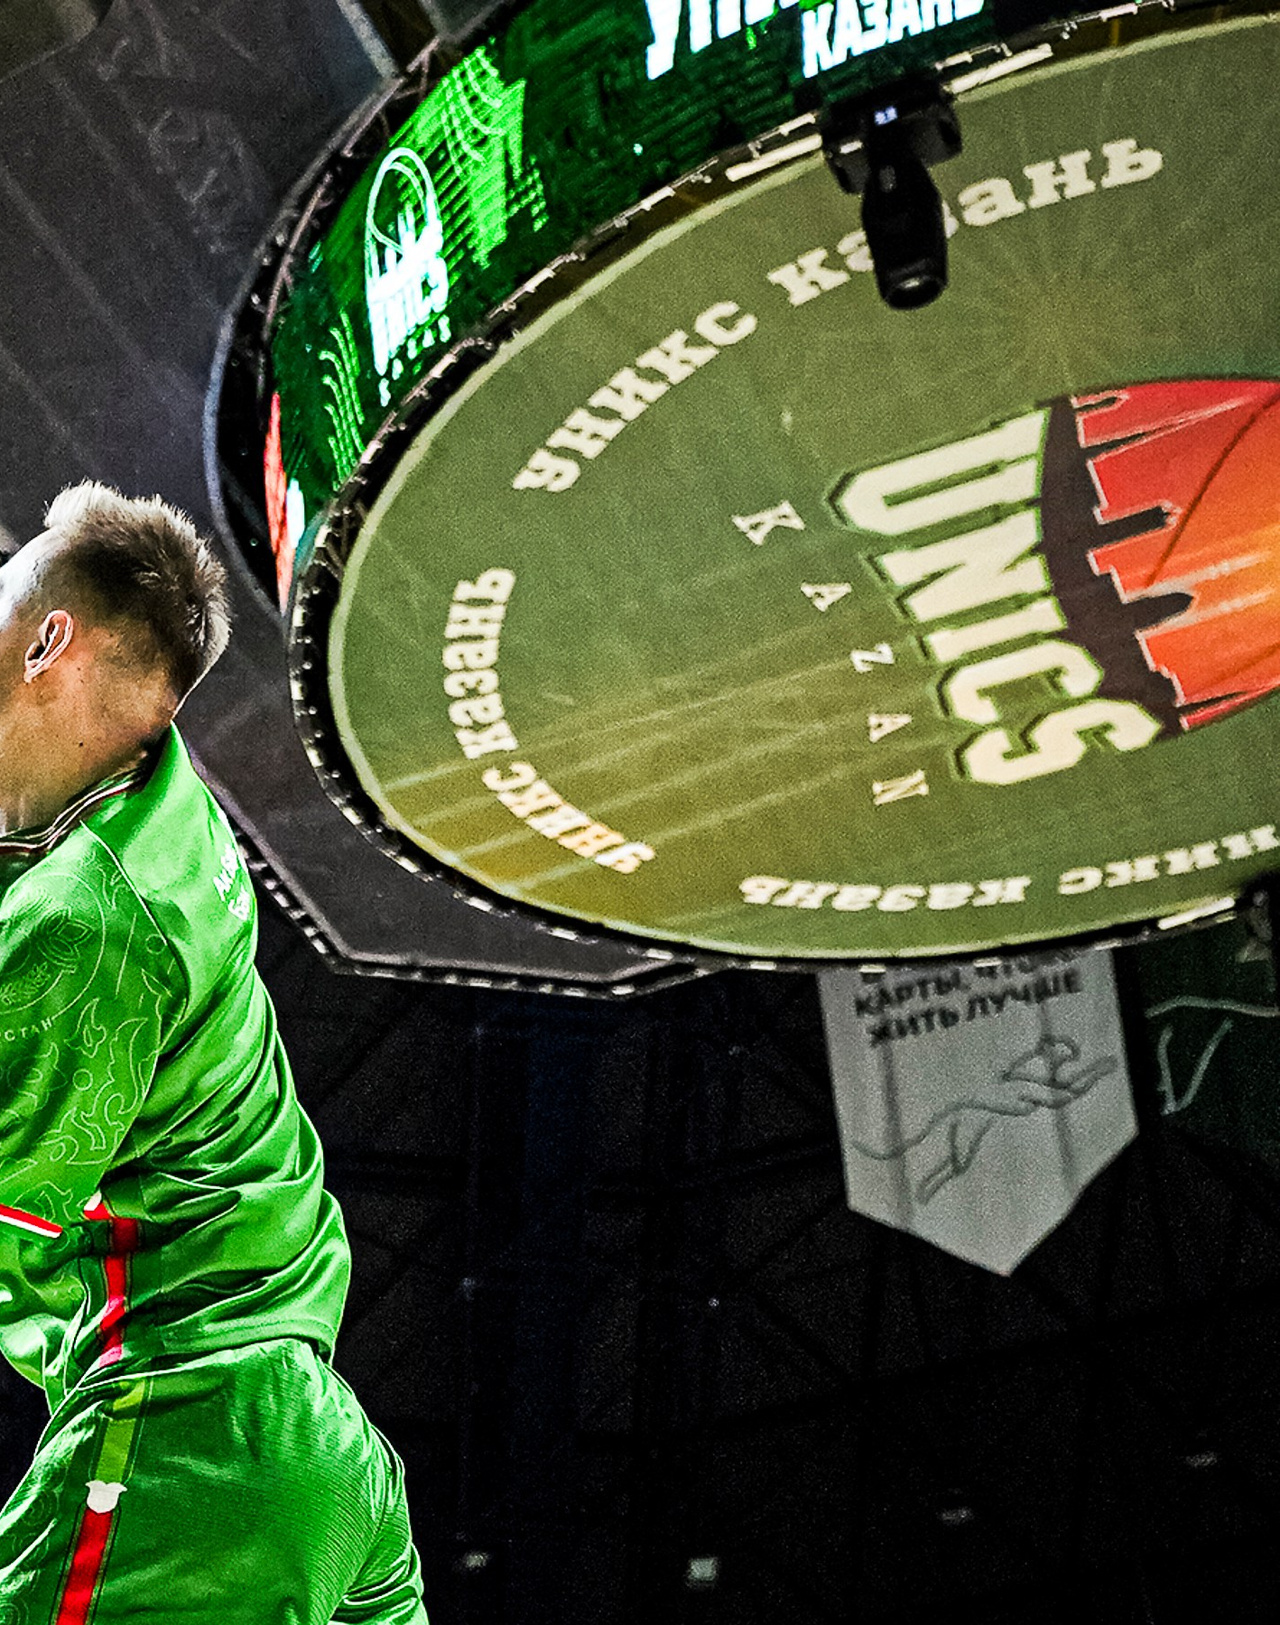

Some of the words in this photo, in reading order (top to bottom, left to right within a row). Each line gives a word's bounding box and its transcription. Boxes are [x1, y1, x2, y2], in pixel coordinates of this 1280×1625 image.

[802, 0, 985, 79] КАЗА
[767, 138, 1164, 307] каань
[840, 407, 1162, 786] UNICS
[1058, 823, 1280, 895] НИКС
[869, 1006, 960, 1048] ЖИТЬ
[966, 968, 1082, 1022] ЛУЧШЕ
